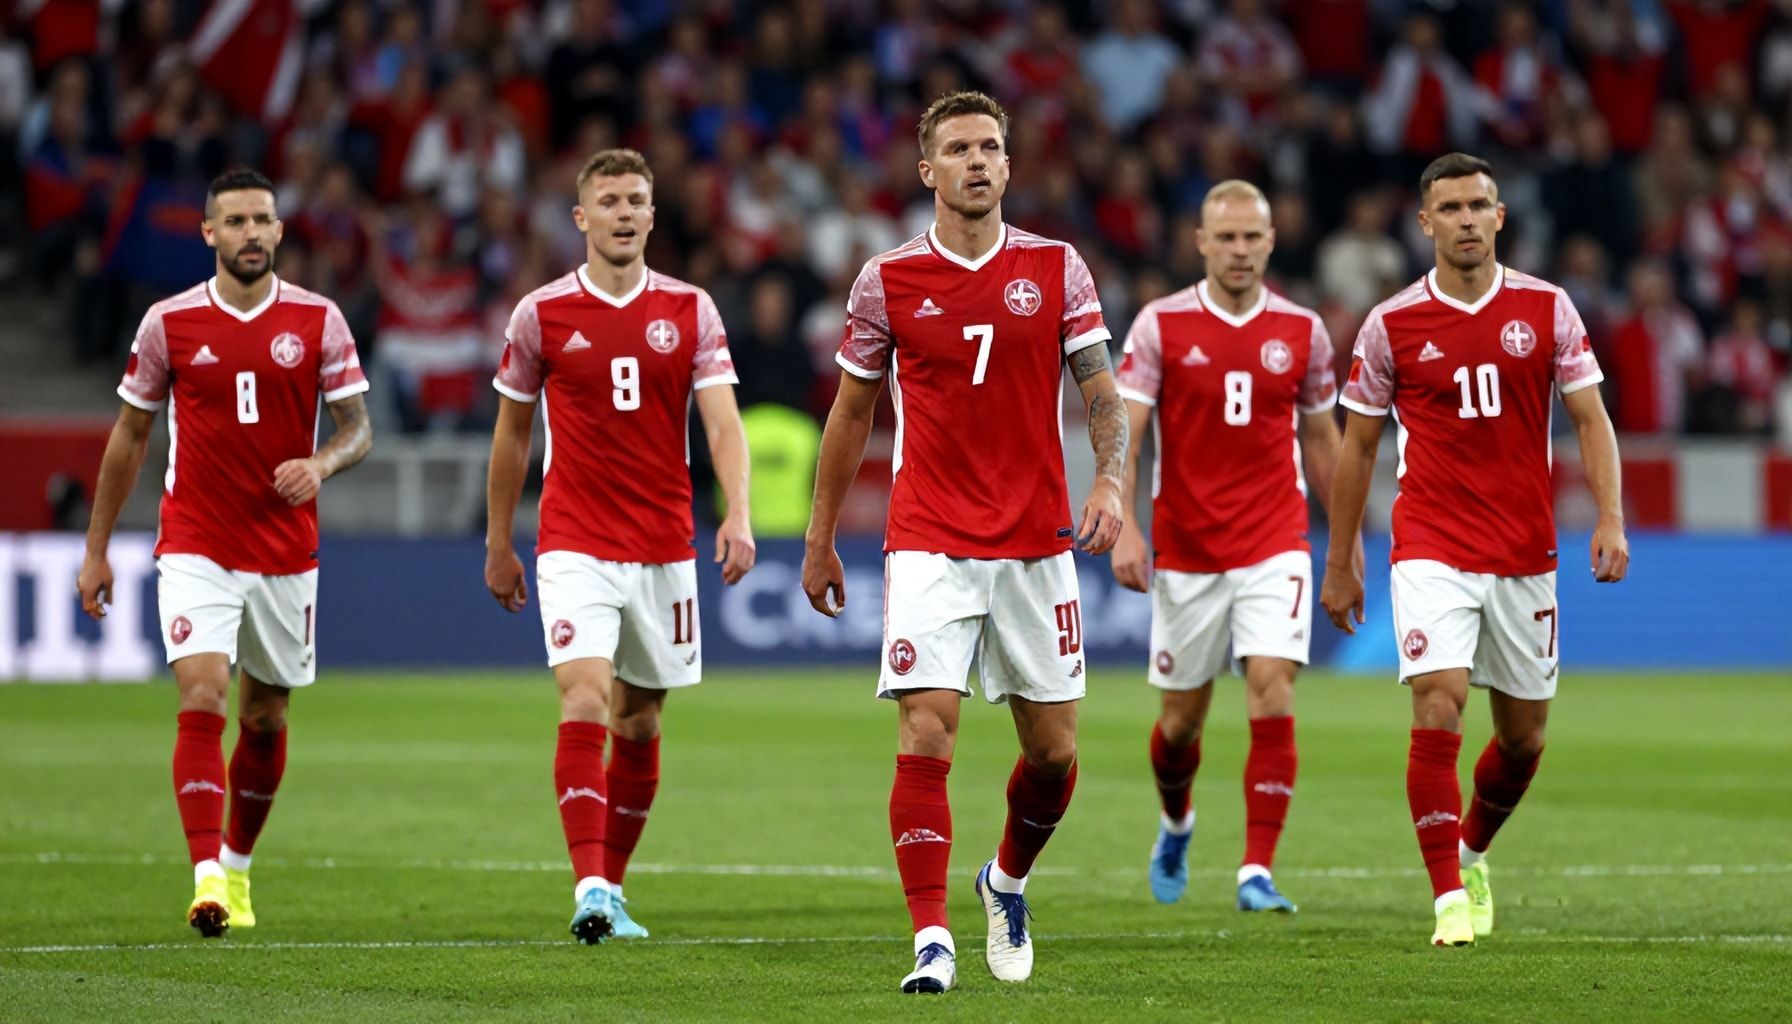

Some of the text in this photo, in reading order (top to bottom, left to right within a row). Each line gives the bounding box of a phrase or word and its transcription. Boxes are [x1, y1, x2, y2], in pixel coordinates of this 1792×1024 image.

[963, 323, 994, 385] 7
[611, 356, 641, 411] 9
[1224, 370, 1253, 426] 8
[1453, 363, 1501, 418] 10
[1288, 575, 1304, 619] 7
